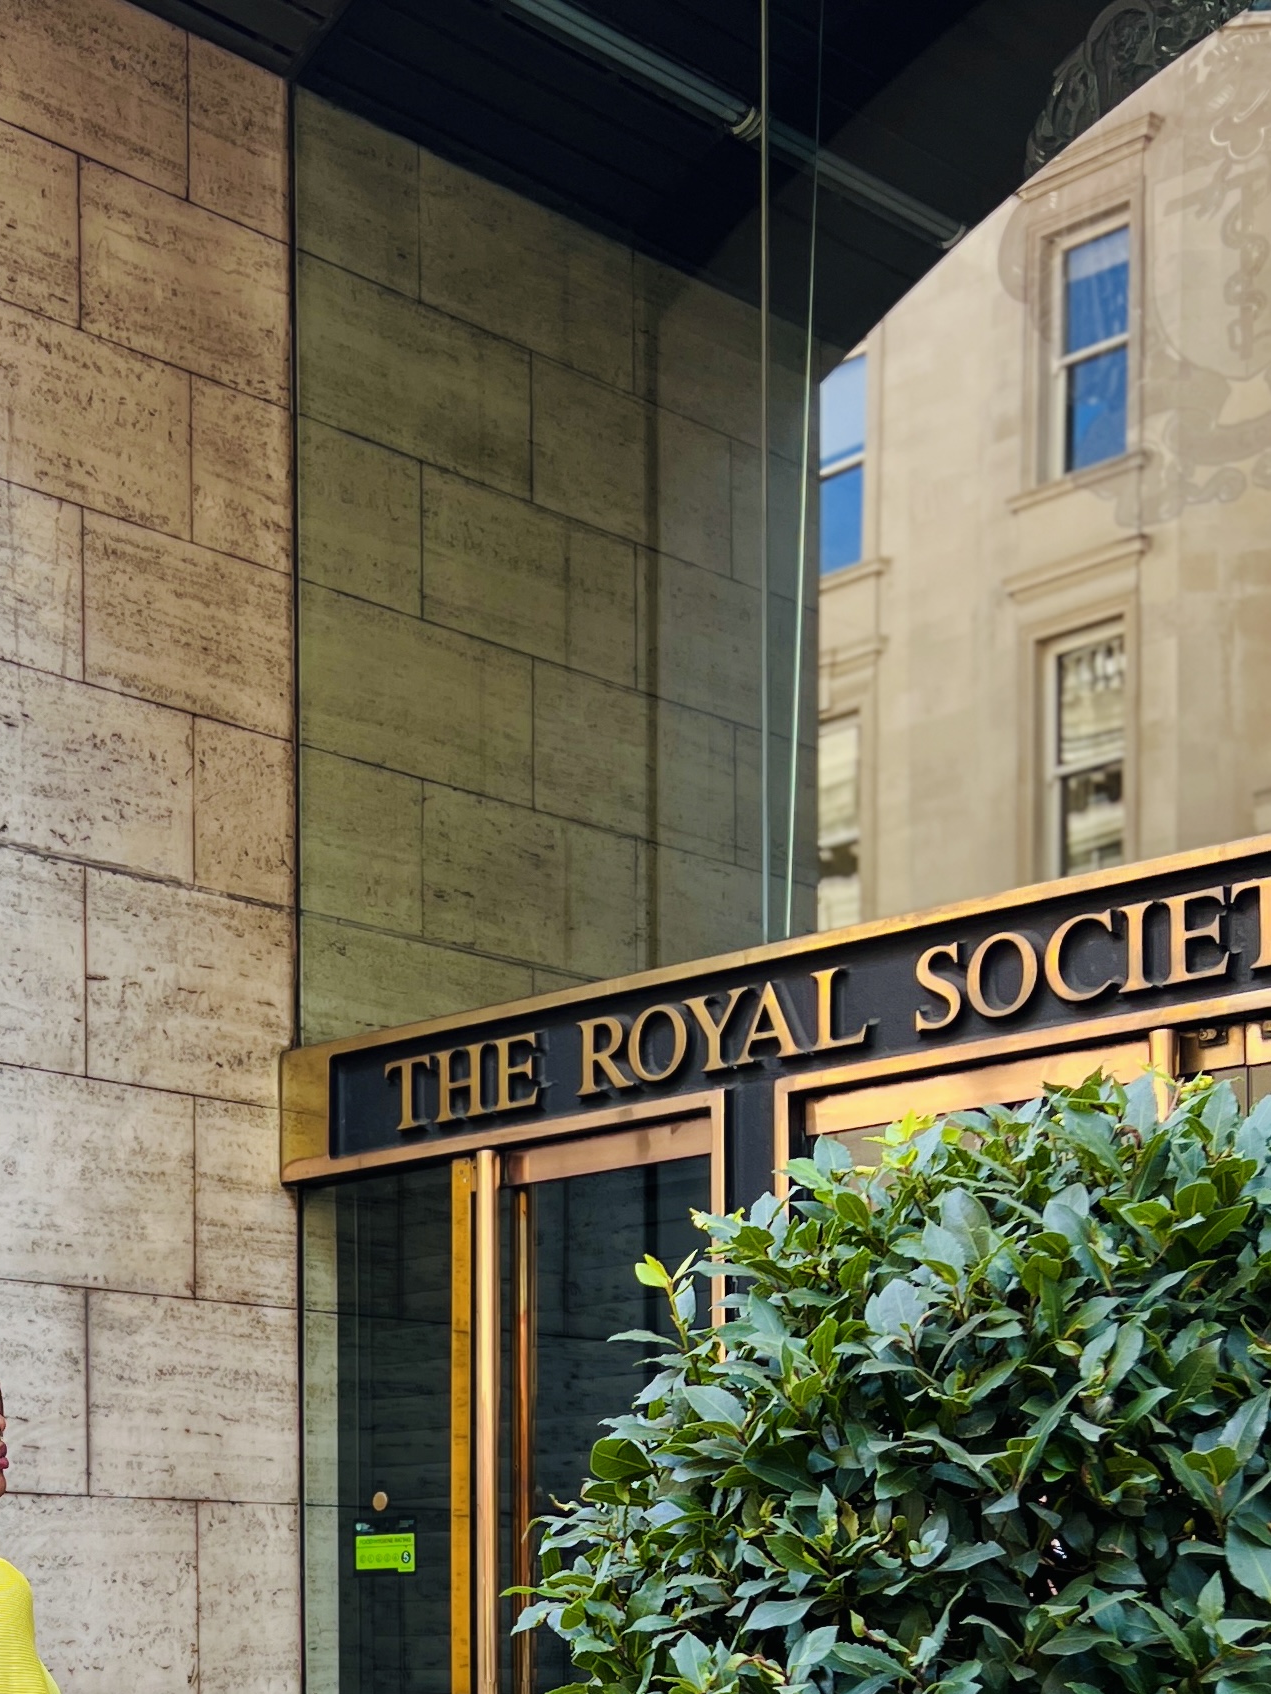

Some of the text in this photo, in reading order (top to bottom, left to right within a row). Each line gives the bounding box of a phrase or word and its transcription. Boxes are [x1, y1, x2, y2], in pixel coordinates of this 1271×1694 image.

[384, 1030, 542, 1132] THE
[576, 965, 870, 1097] ROYAL
[403, 1552, 409, 1562] 5
